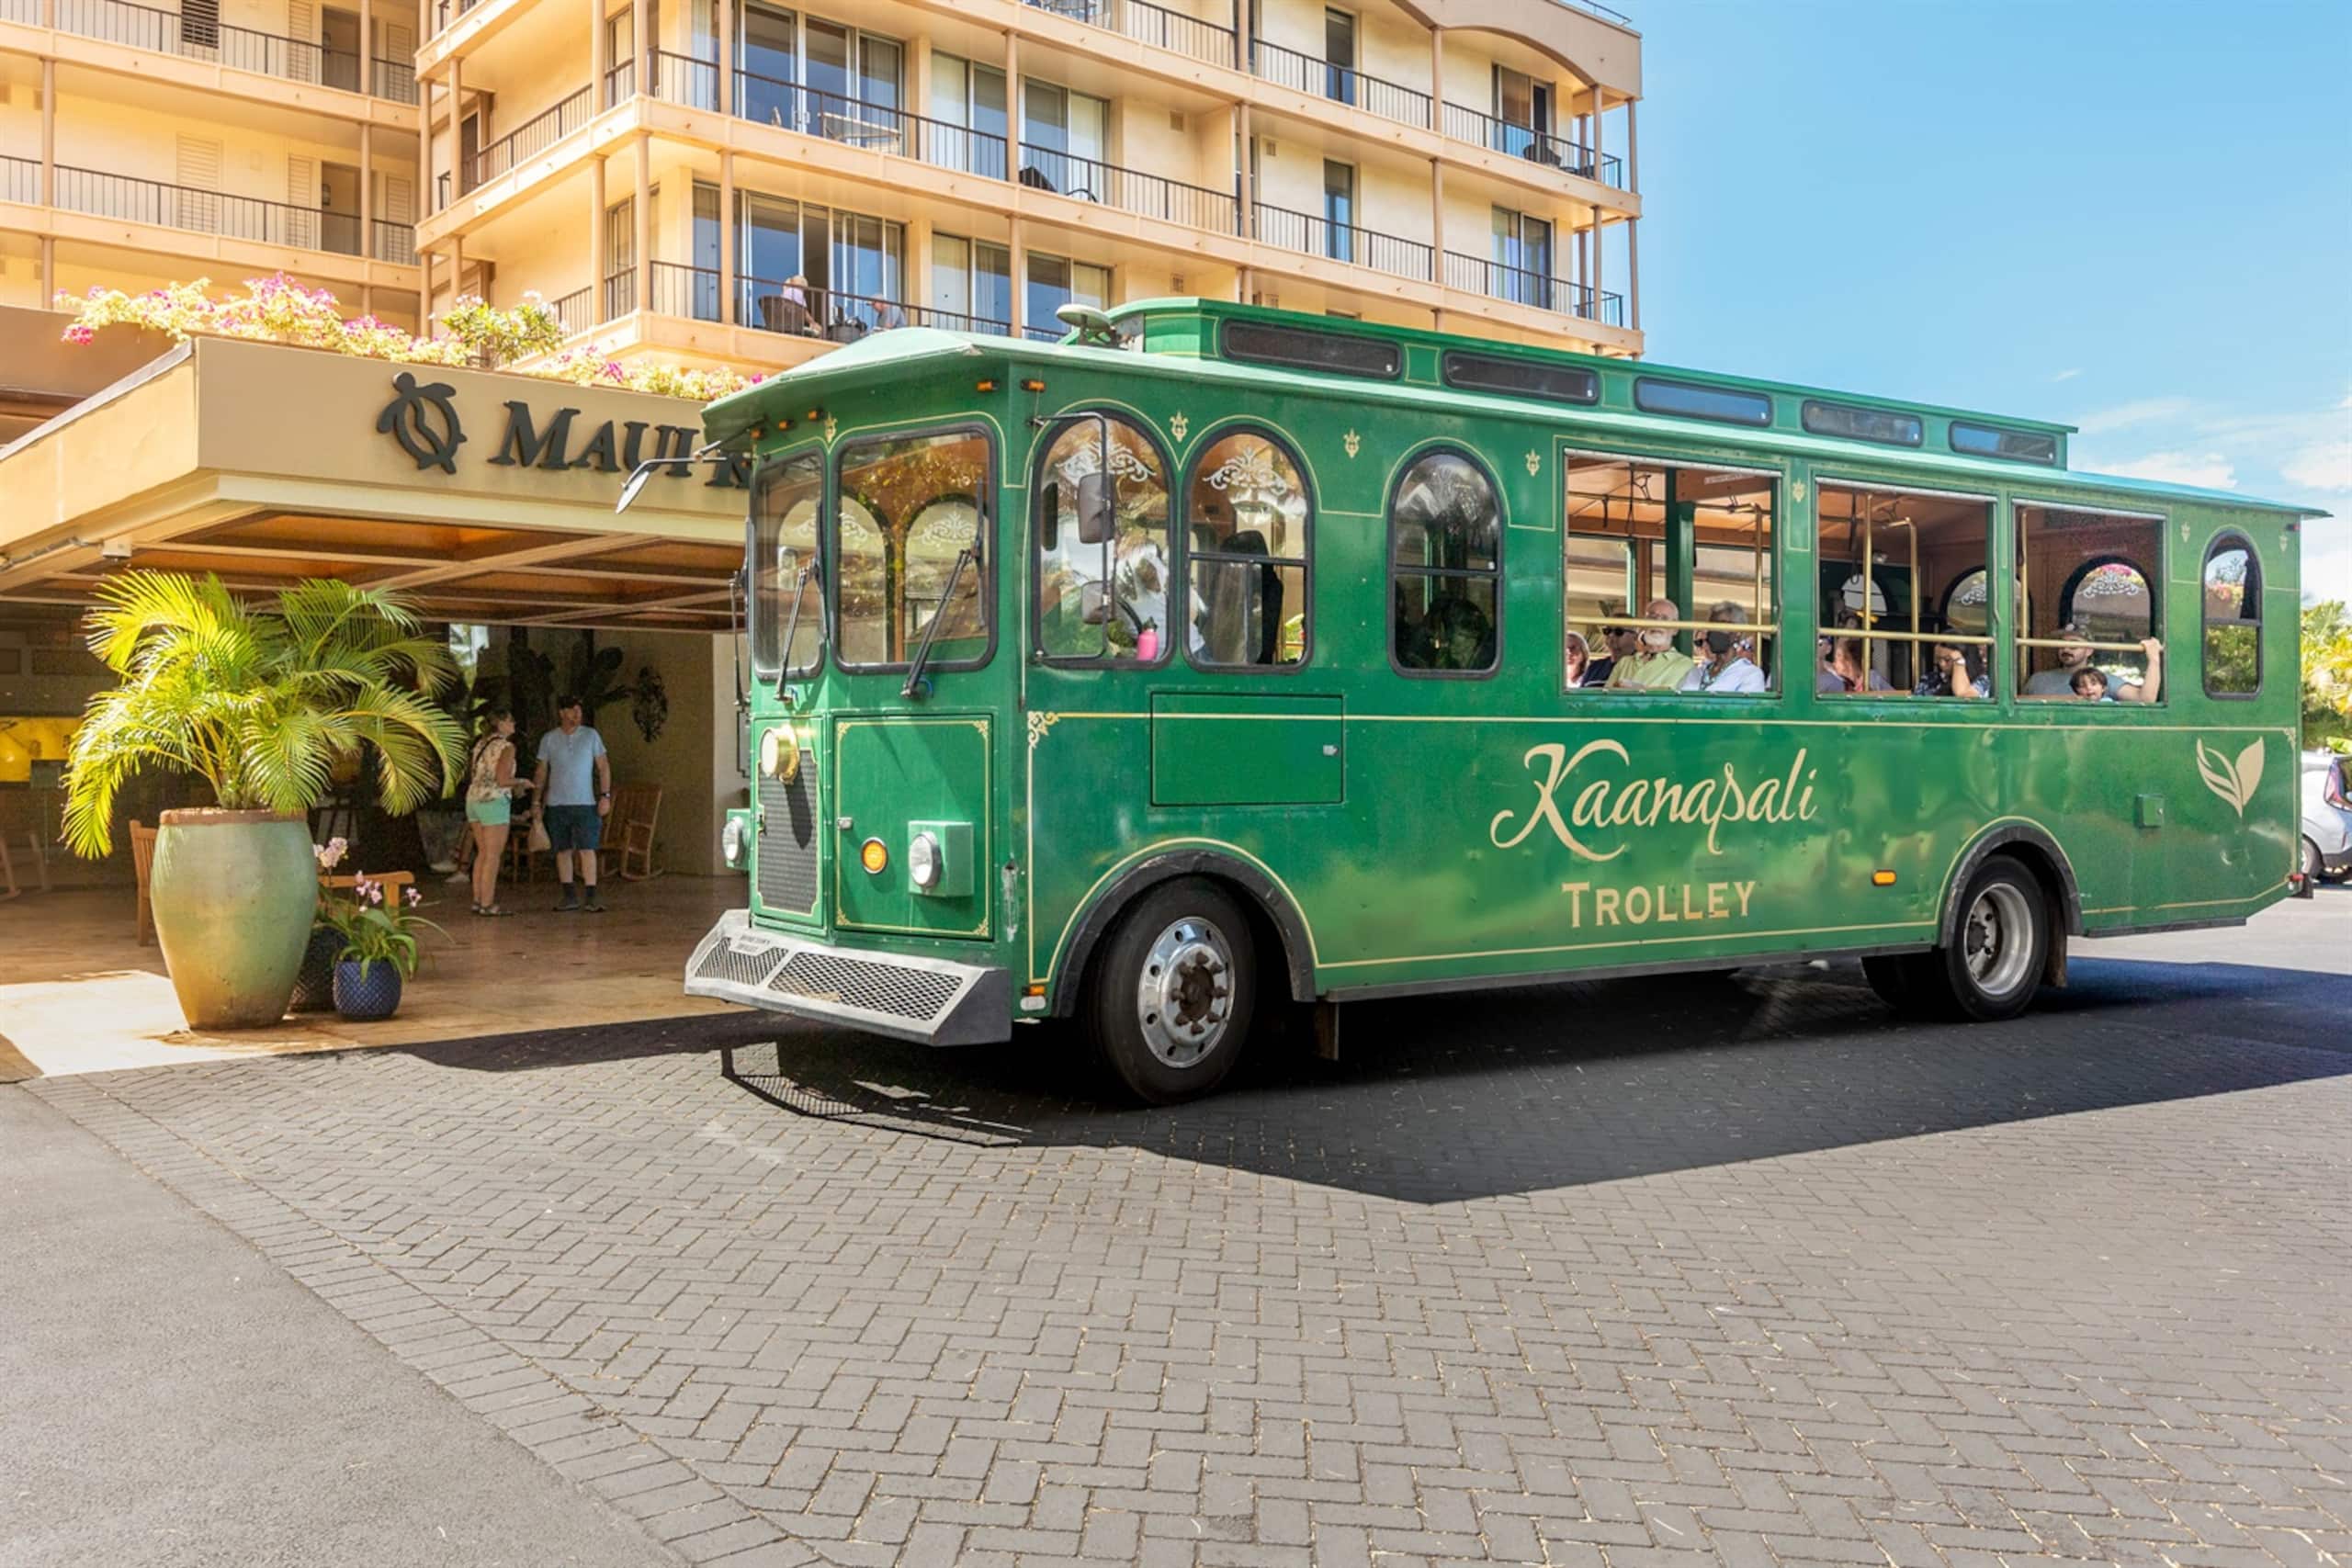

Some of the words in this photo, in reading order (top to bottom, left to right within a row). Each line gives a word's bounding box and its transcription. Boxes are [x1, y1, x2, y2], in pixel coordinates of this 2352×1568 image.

[487, 400, 700, 478] MAUI
[1489, 739, 1817, 862] Kaanapali
[1562, 880, 1757, 928] TROLLEY
